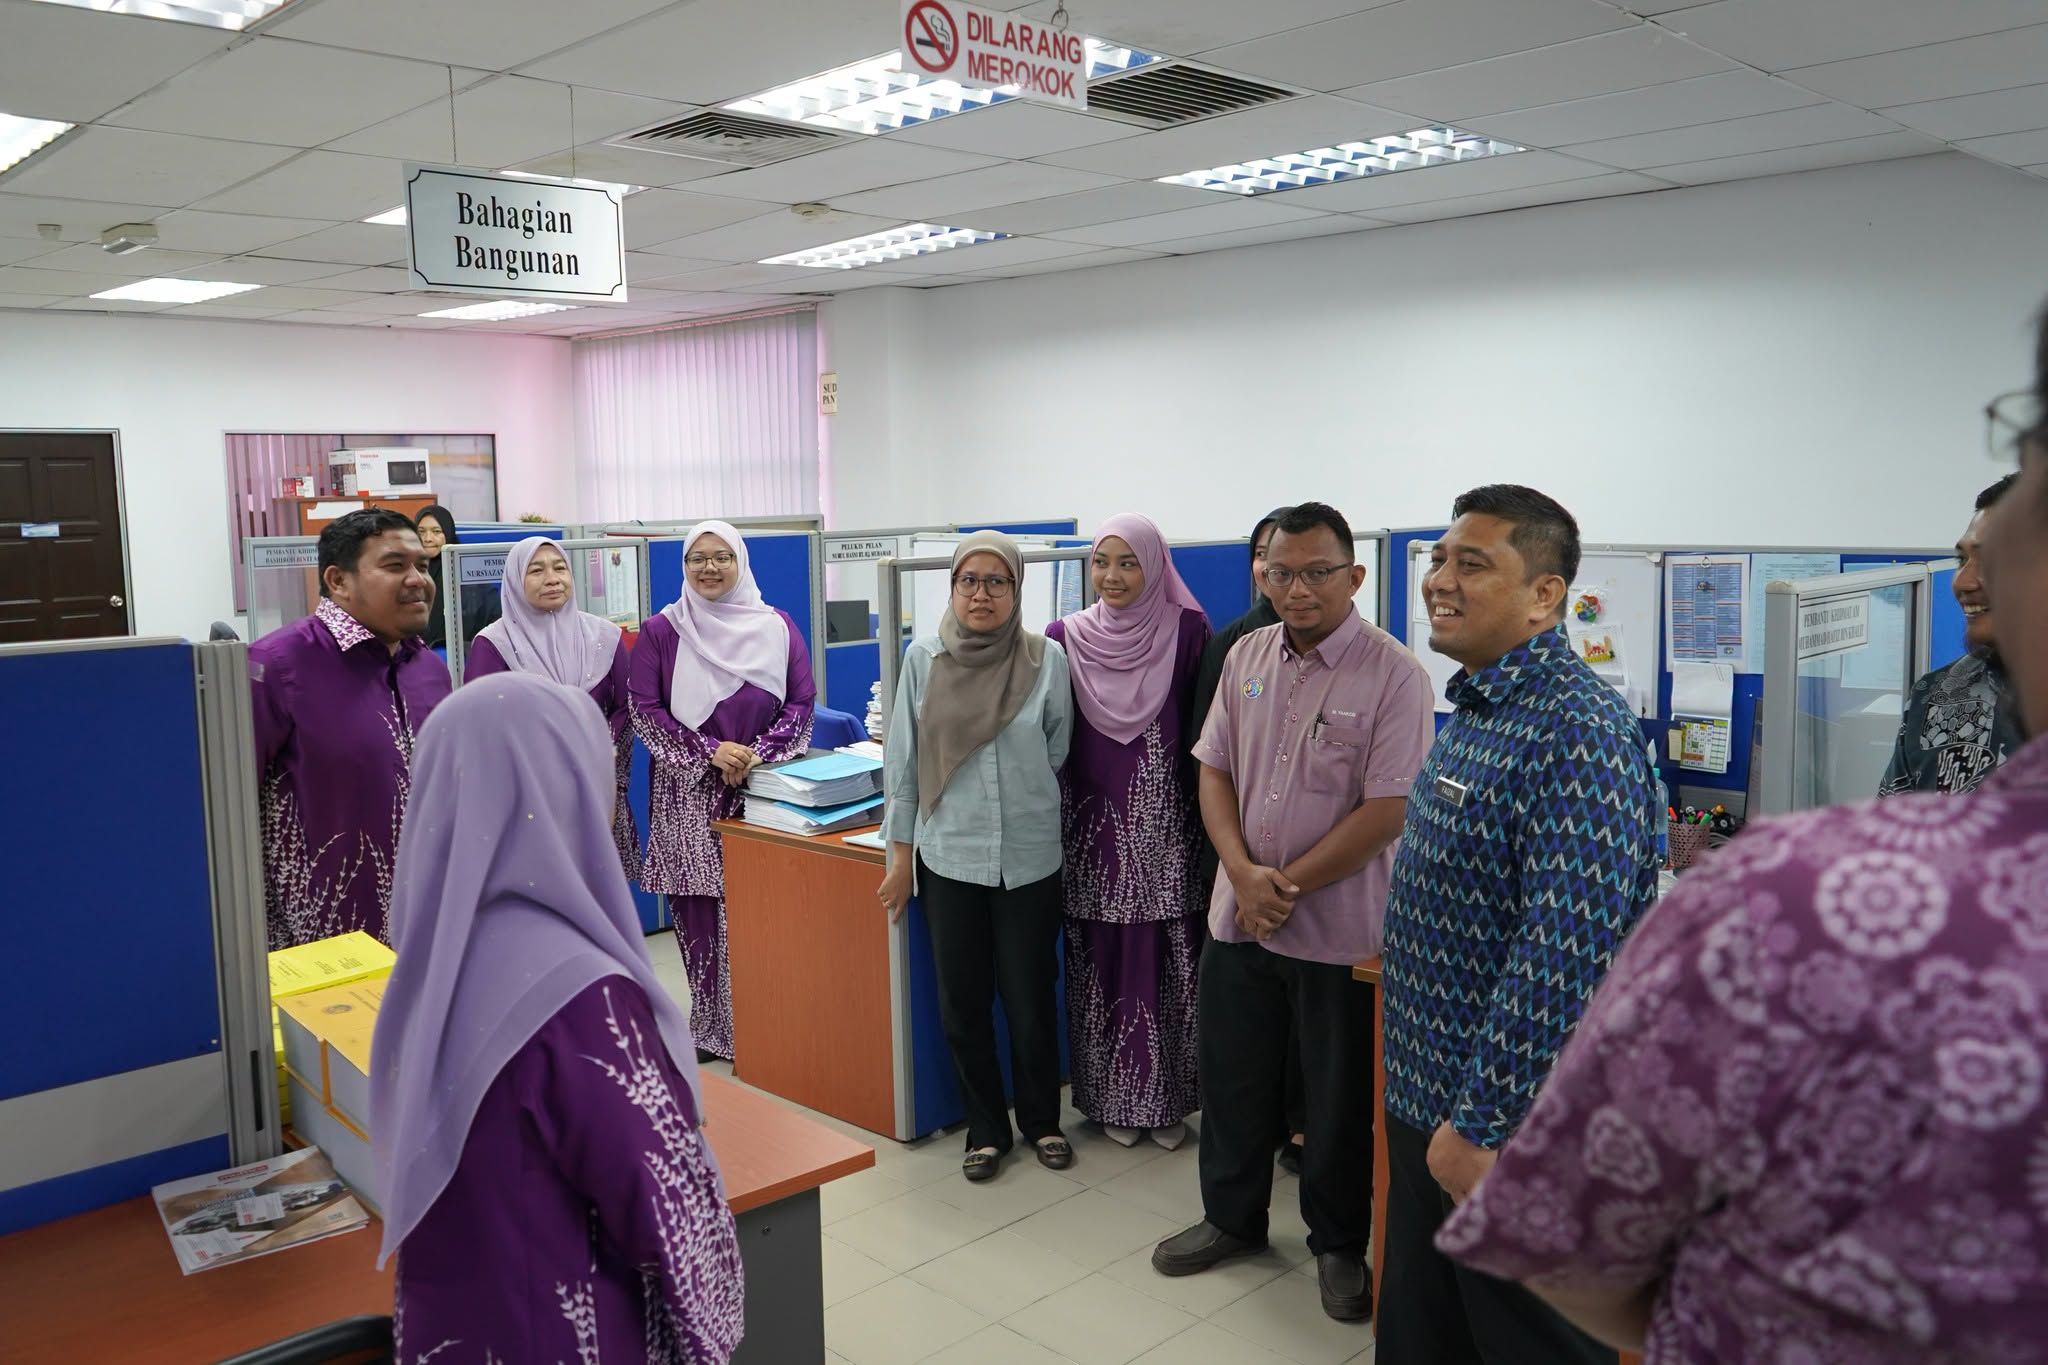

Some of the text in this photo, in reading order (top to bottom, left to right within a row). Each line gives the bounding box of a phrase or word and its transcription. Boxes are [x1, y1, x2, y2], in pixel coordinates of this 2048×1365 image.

[967, 11, 1082, 64] DILARANG
[967, 49, 1076, 99] MEROKOK
[456, 191, 573, 239] Bahagian
[454, 235, 580, 280] Bangunan
[823, 383, 838, 393] SUD
[297, 547, 318, 555] KHIDM
[466, 569, 504, 577] NURSYAZAN
